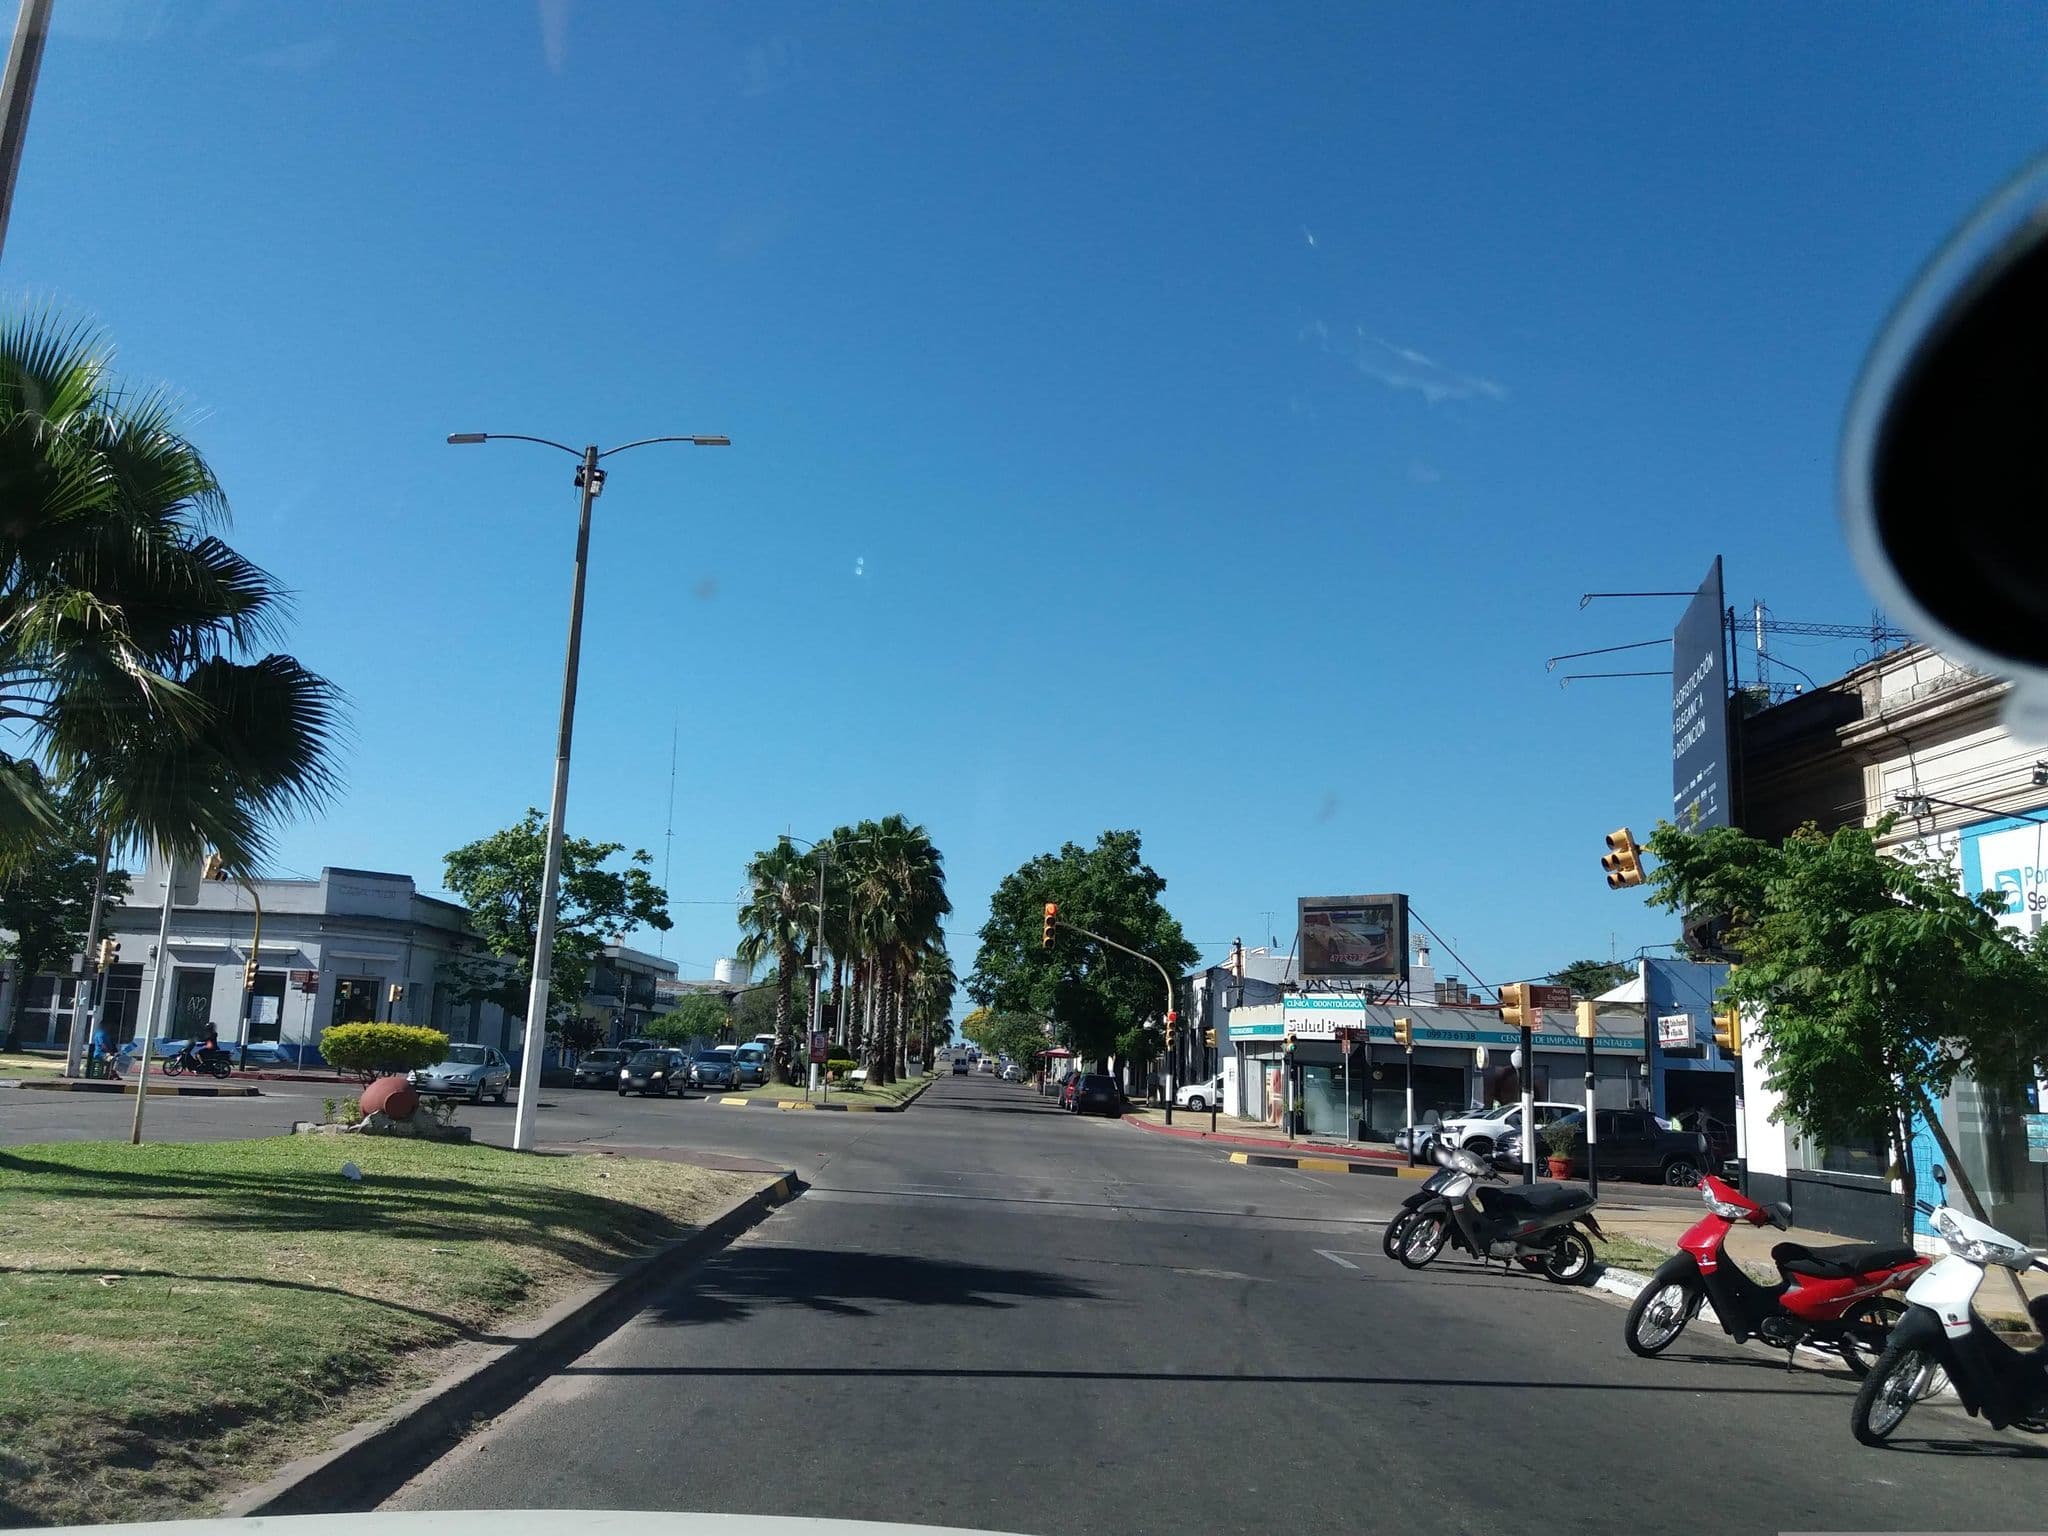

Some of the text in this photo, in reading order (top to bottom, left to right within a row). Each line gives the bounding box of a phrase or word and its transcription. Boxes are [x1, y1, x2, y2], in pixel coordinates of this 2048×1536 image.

[1676, 692, 1703, 734] ELEGANA
[1286, 1000, 1363, 1008] CLÍNICA ODONTOLÓGICA
[1287, 1018, 1325, 1033] Salud
[1535, 1036, 1547, 1044] DE
